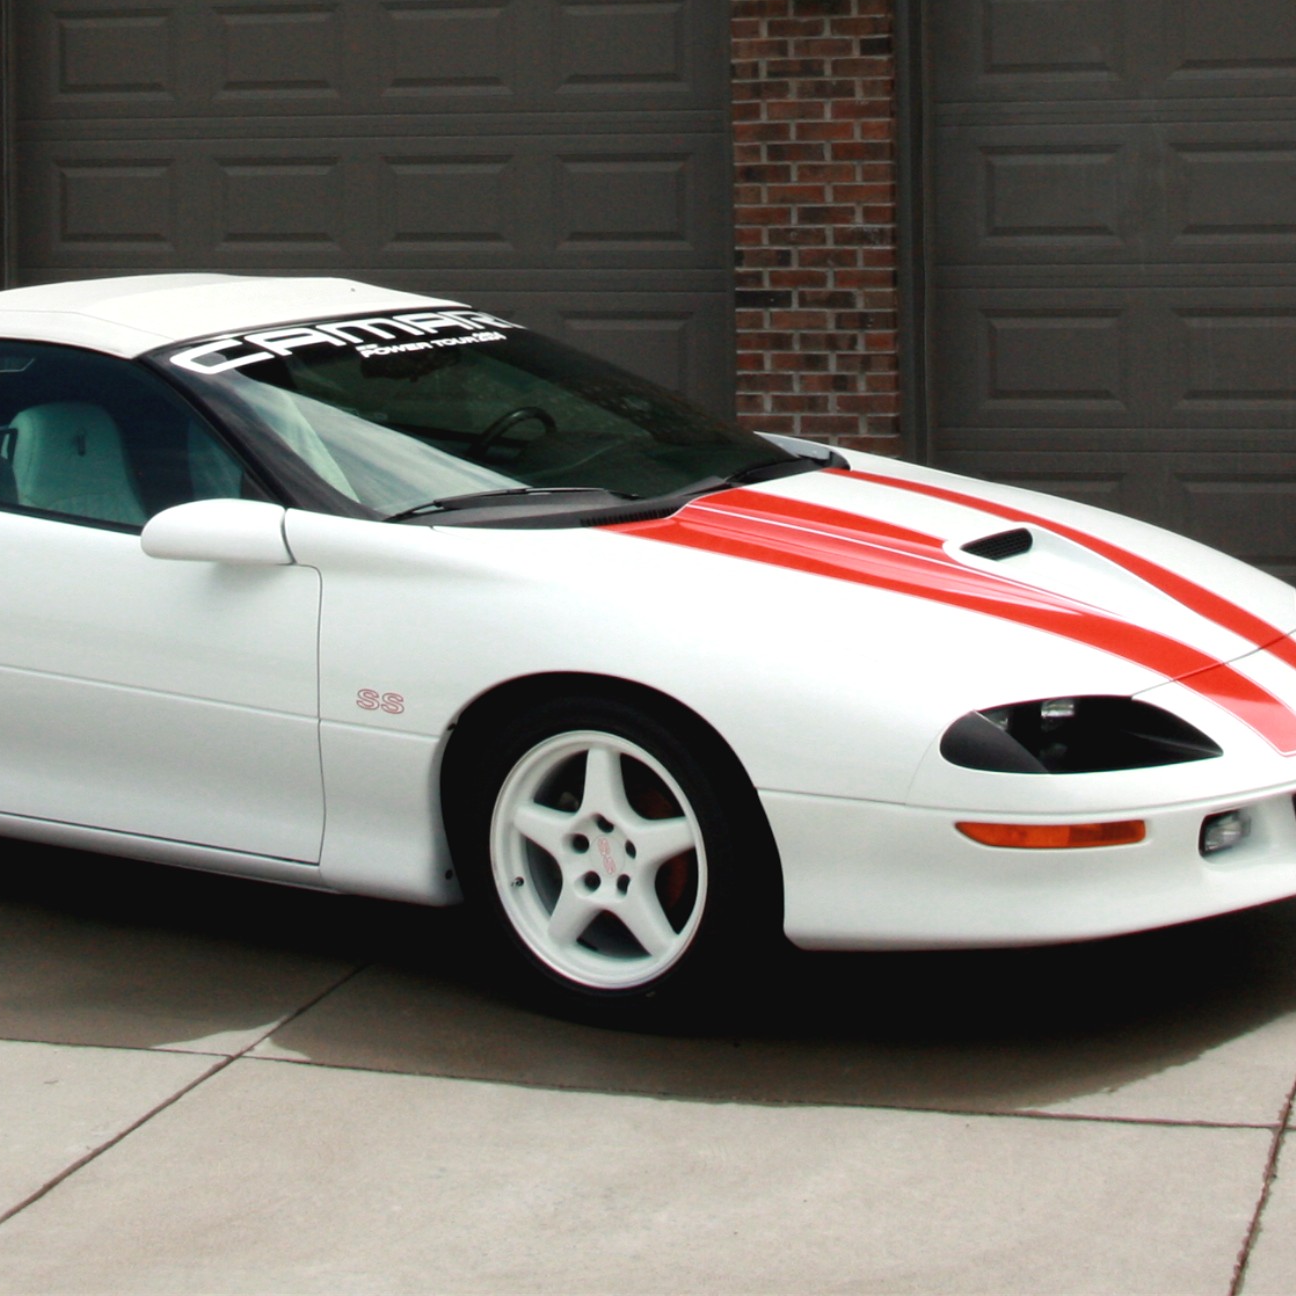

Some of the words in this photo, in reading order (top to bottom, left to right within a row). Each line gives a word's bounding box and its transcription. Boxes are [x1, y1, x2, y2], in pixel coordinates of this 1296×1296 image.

[360, 341, 433, 358] POWER
[431, 335, 478, 348] TOUR
[356, 685, 405, 715] SS
